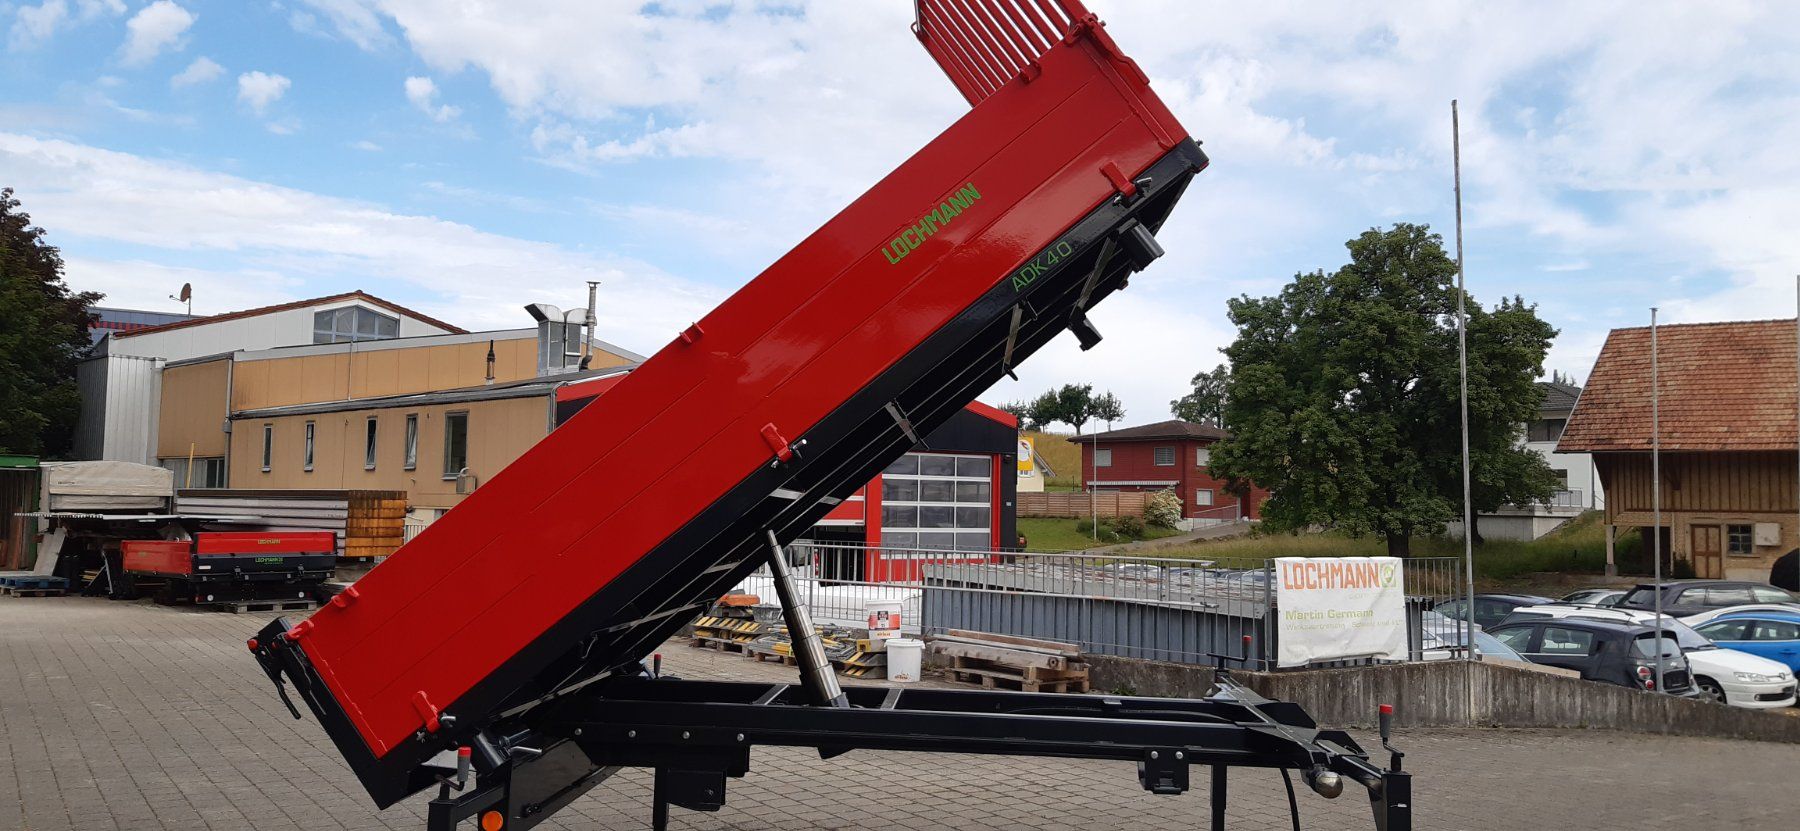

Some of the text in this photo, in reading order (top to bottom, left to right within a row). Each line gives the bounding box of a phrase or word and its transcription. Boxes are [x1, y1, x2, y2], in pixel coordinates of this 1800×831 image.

[882, 182, 982, 265] LOCHMANN
[1011, 259, 1048, 292] ADK
[1282, 562, 1380, 589] LOCHMANN
[1285, 610, 1324, 621] Martin
